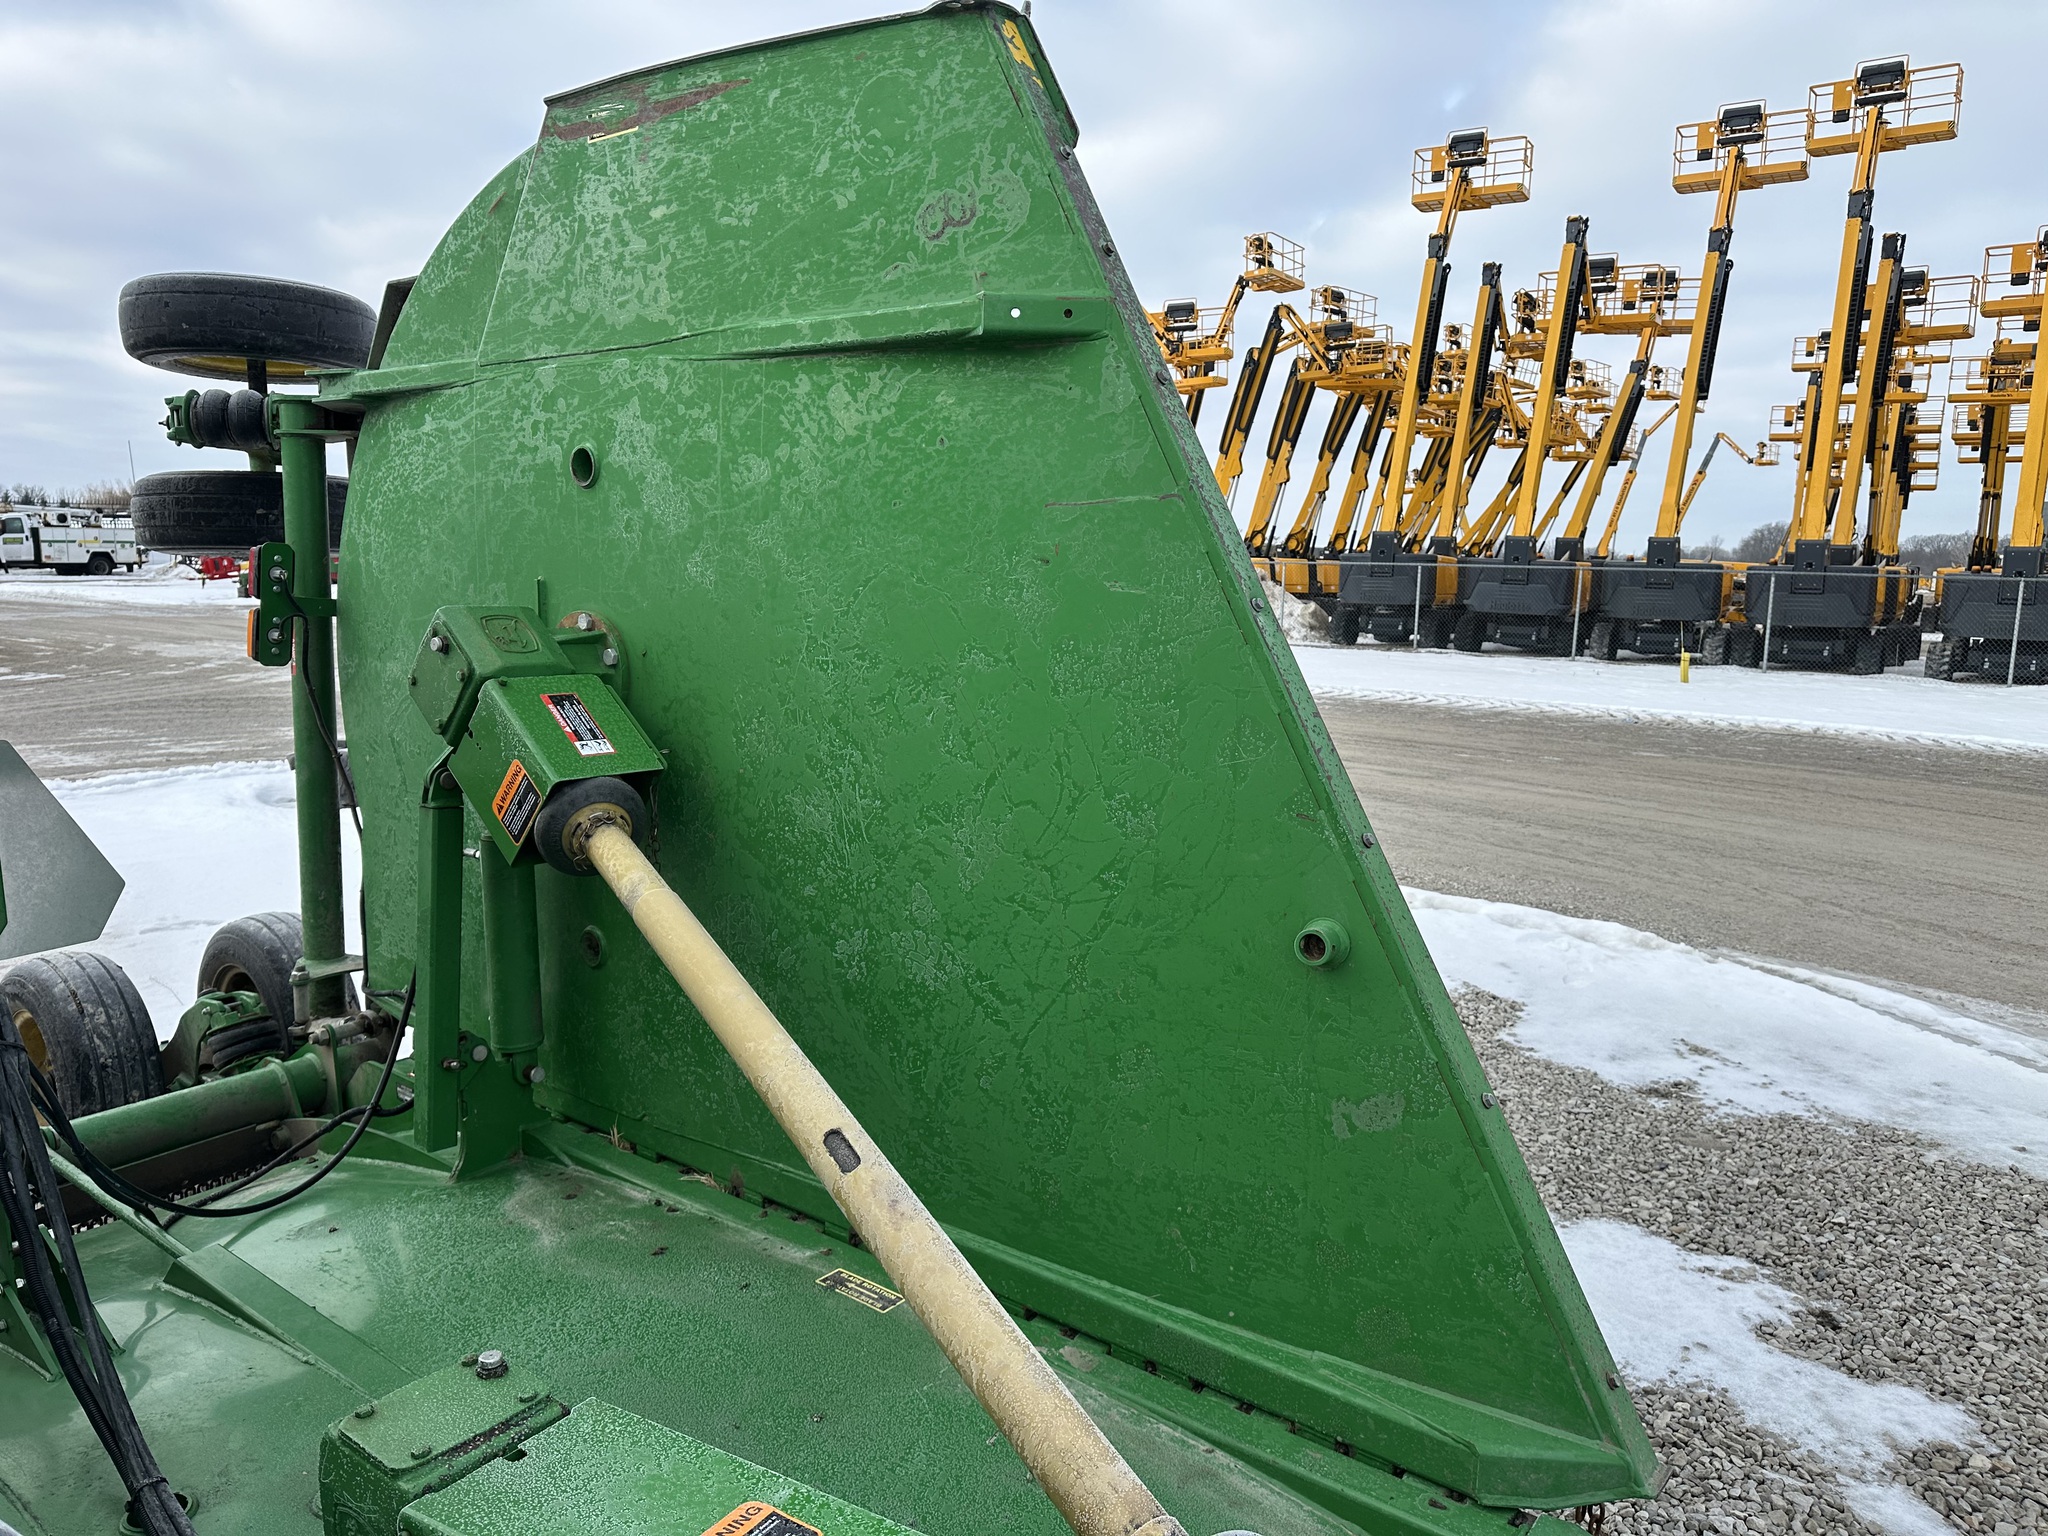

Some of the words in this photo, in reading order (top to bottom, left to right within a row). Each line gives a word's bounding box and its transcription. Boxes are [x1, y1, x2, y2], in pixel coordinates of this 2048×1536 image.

[547, 704, 567, 727] DANGER
[499, 764, 522, 804] WARNING
[840, 1272, 861, 1285] BLADE
[862, 1282, 897, 1300] ROTATION
[860, 1295, 883, 1308] BLADE
